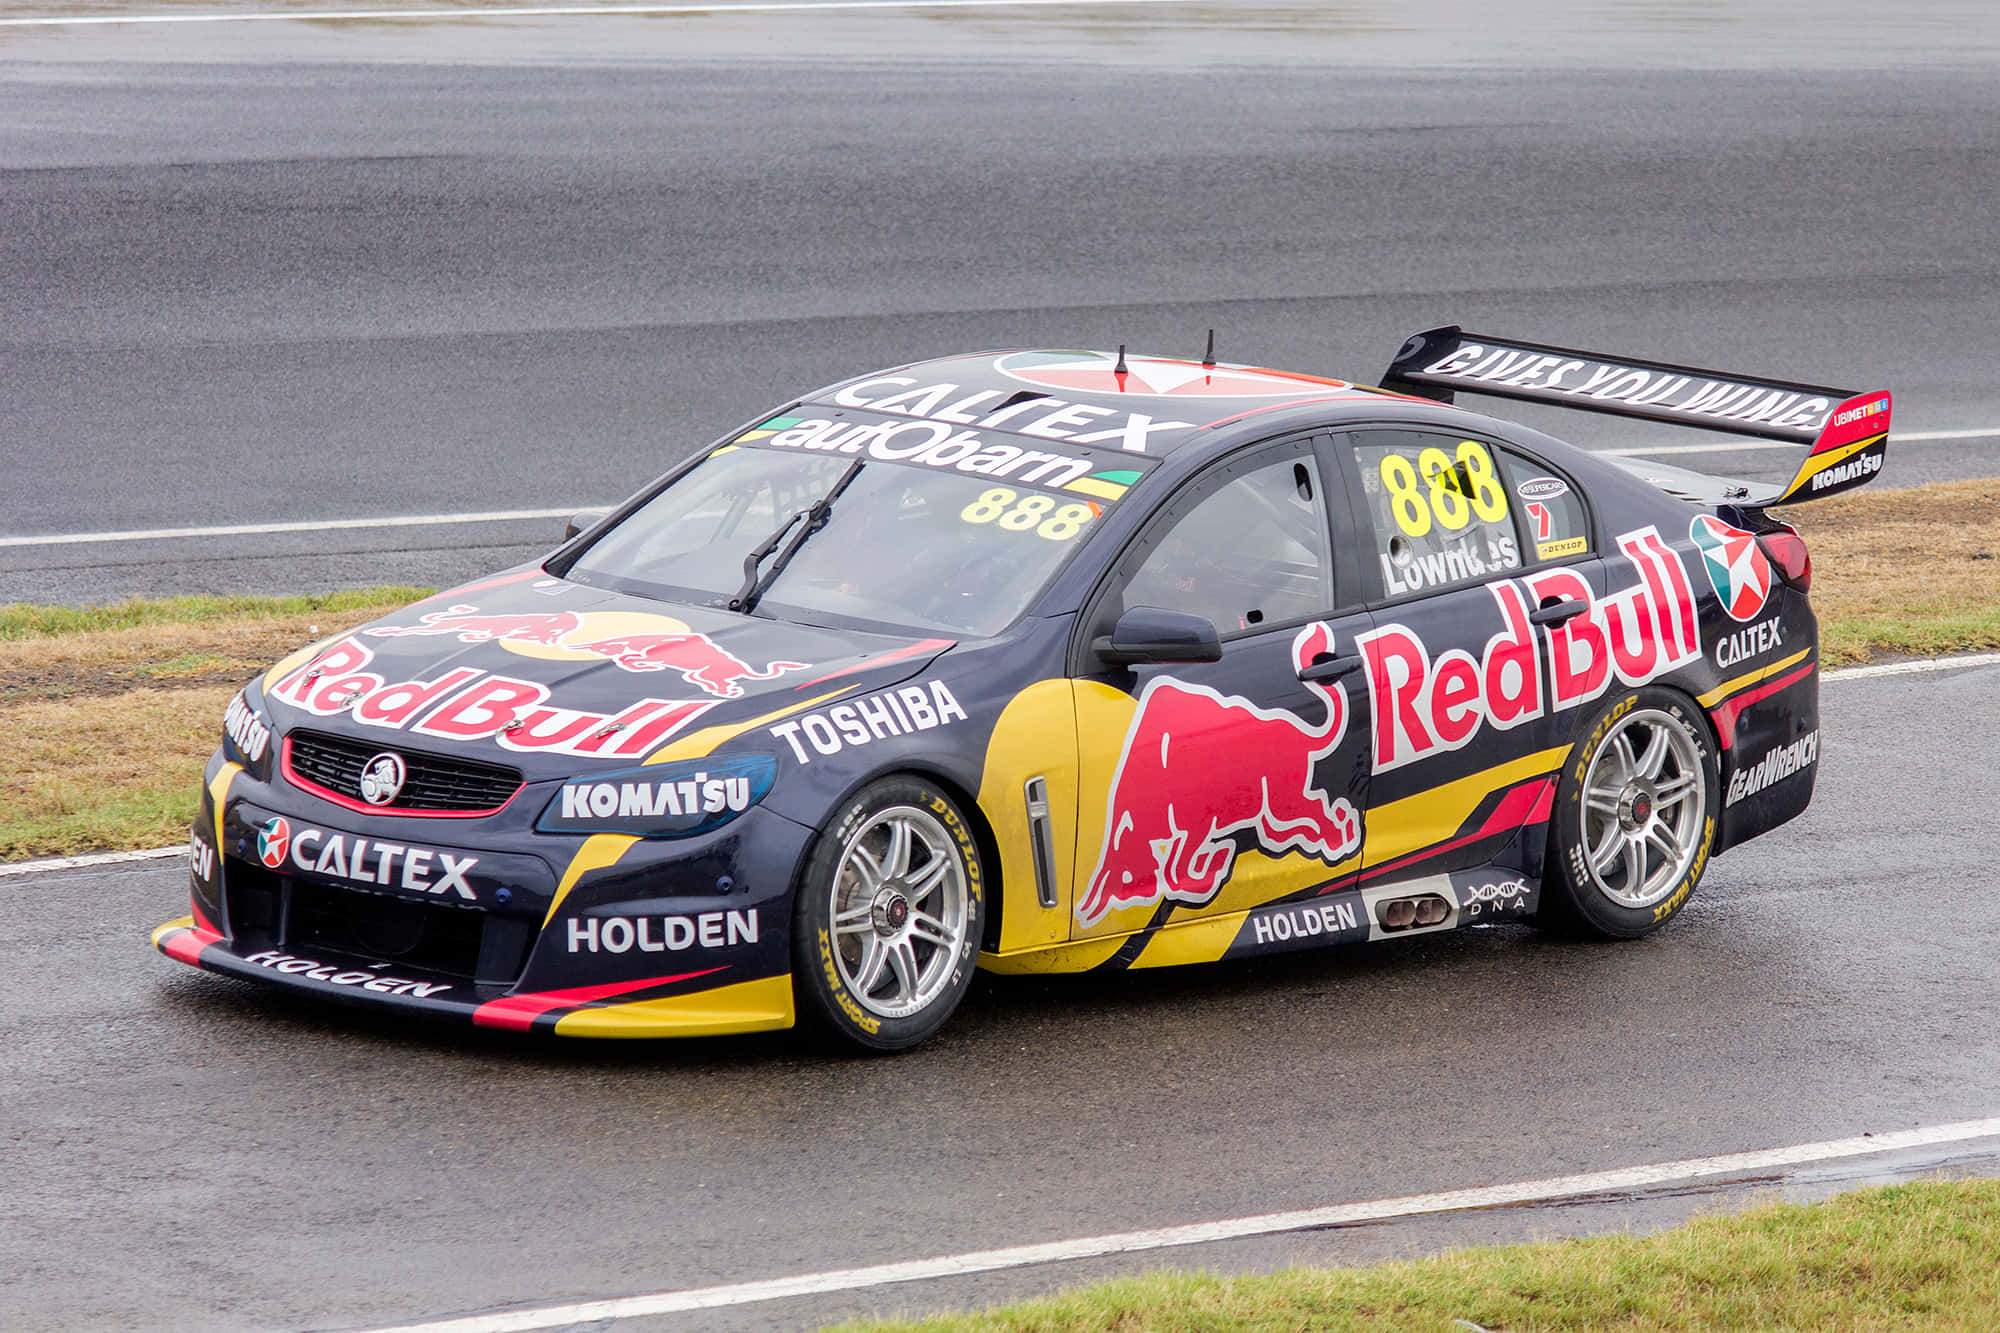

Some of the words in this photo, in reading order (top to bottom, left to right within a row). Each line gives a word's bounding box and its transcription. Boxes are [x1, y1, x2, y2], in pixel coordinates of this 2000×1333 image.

[1423, 345, 1585, 389] GIVES
[1561, 365, 1692, 405] YOU
[834, 377, 1198, 453] CALTEX
[1834, 405, 1868, 427] UBIMET
[1380, 441, 1507, 537] 888
[1812, 453, 1883, 491] KOMATSU
[960, 487, 1092, 540] 888
[1548, 540, 1583, 553] DUNLOP
[1354, 579, 1544, 776] Red
[1522, 525, 1702, 712] Bull
[1716, 616, 1782, 668] CALTEX
[270, 635, 486, 729] Red
[410, 673, 727, 761] Bull
[769, 679, 968, 765] TOSHIBA
[1574, 694, 1639, 785] DUNLOP
[561, 772, 750, 819] KOMATSU
[290, 829, 480, 901] CALTEX
[929, 796, 983, 902] DUNLOP
[567, 908, 759, 954] HOLDEN
[1253, 903, 1357, 944] HOLDEN
[244, 950, 453, 999] HOLDEN
